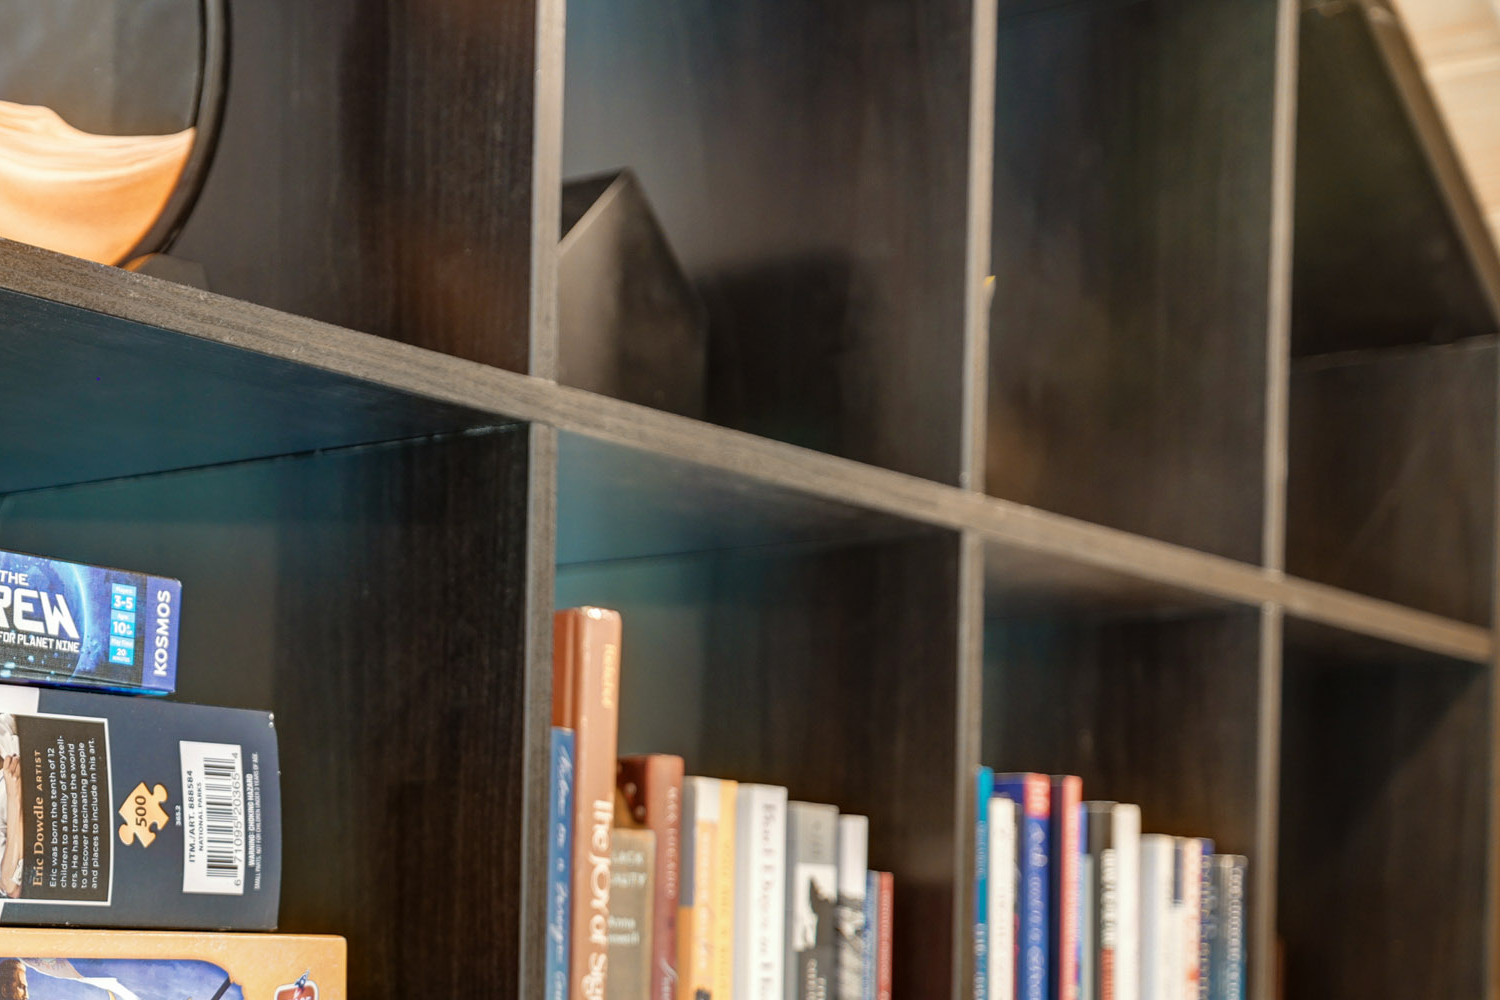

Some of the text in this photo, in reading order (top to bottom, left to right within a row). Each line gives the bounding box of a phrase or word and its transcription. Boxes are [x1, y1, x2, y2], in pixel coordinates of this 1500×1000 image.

[0, 569, 28, 586] THE
[114, 595, 133, 610] 3-5
[17, 633, 53, 649] PLANET
[55, 639, 79, 653] NINE
[153, 590, 171, 677] KOSMOS
[33, 797, 44, 854] Dowdle
[135, 794, 147, 827] 500
[591, 799, 614, 851] The
[32, 859, 44, 886] Eric
[588, 914, 609, 944] of
